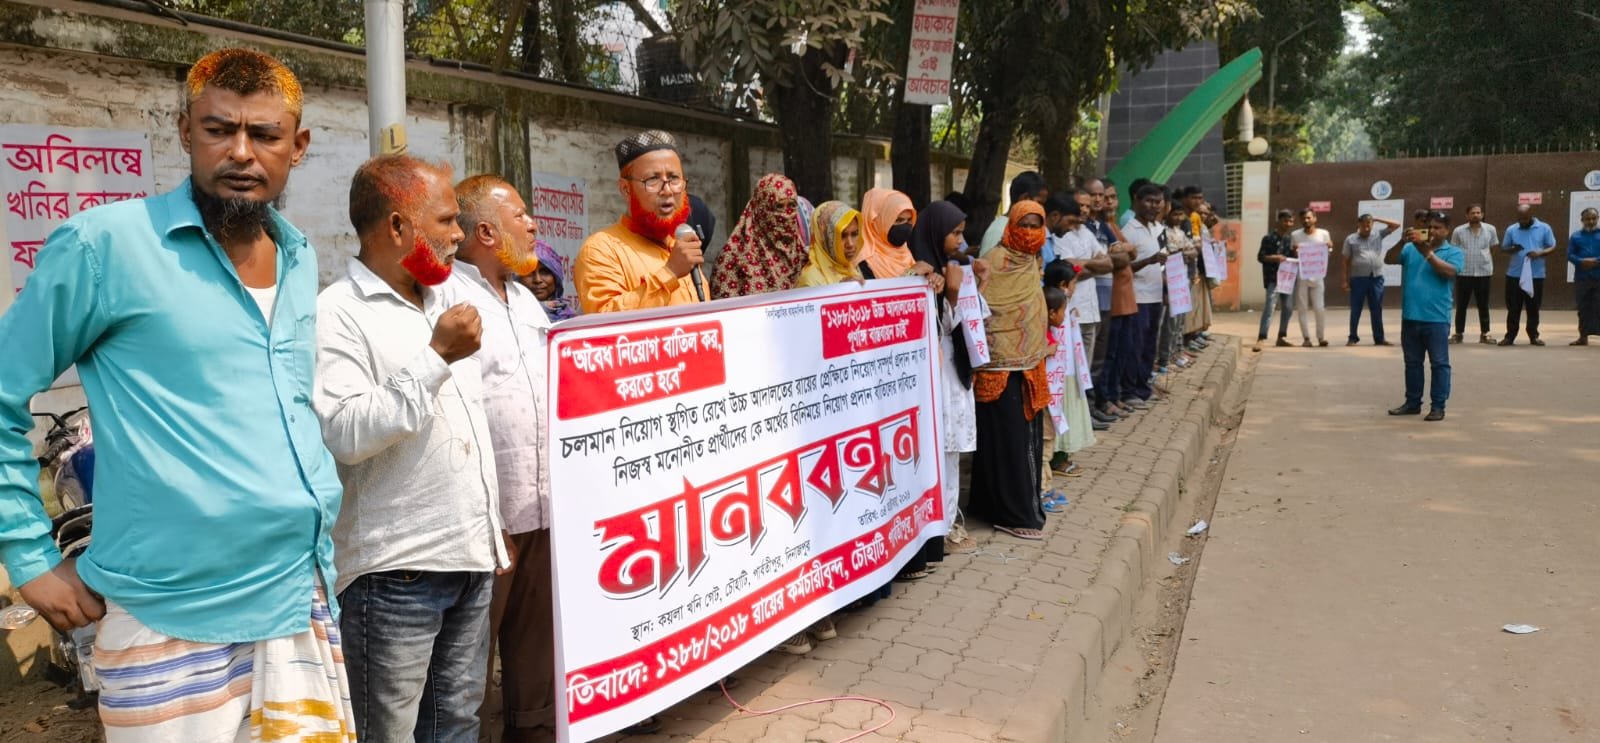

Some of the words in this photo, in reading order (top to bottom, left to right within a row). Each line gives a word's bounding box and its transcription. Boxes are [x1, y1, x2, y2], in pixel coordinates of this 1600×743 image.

[907, 72, 949, 96] অবিচার
[2, 133, 143, 177] অবিলম্বে
[7, 180, 70, 220] খনির
[561, 341, 614, 373] “অবৈধ
[616, 335, 660, 367] নিয়োগ
[663, 327, 699, 359] বাতিল
[700, 328, 723, 353] কর,
[615, 371, 654, 401] করতে
[657, 363, 686, 394] হবে”
[559, 427, 617, 459] চলমান
[619, 416, 663, 447] নিয়োগ
[666, 402, 699, 435] স্থগিত
[702, 398, 727, 423] রেখে
[729, 389, 748, 413] উচ্চ
[750, 380, 793, 408] আদালতের
[795, 374, 818, 397] রায়ের
[820, 363, 849, 387] প্রেক্ষিতে
[850, 358, 877, 381] নিয়োগ
[612, 456, 652, 488] নিজস্ব
[655, 435, 705, 471] মনোনীত
[751, 420, 763, 441] কে
[764, 405, 789, 433] অর্থের
[790, 401, 822, 427] বিনিময়ে
[823, 393, 850, 416] নিয়োগ
[850, 387, 874, 409] প্রদান
[594, 405, 921, 600] মানববন্ধন
[658, 605, 684, 627] কয়লা
[686, 594, 702, 615] খনি
[566, 661, 648, 712] তিবাদে:
[656, 612, 749, 679] ১২৮৮/২০১৮
[752, 587, 785, 625] রায়ের
